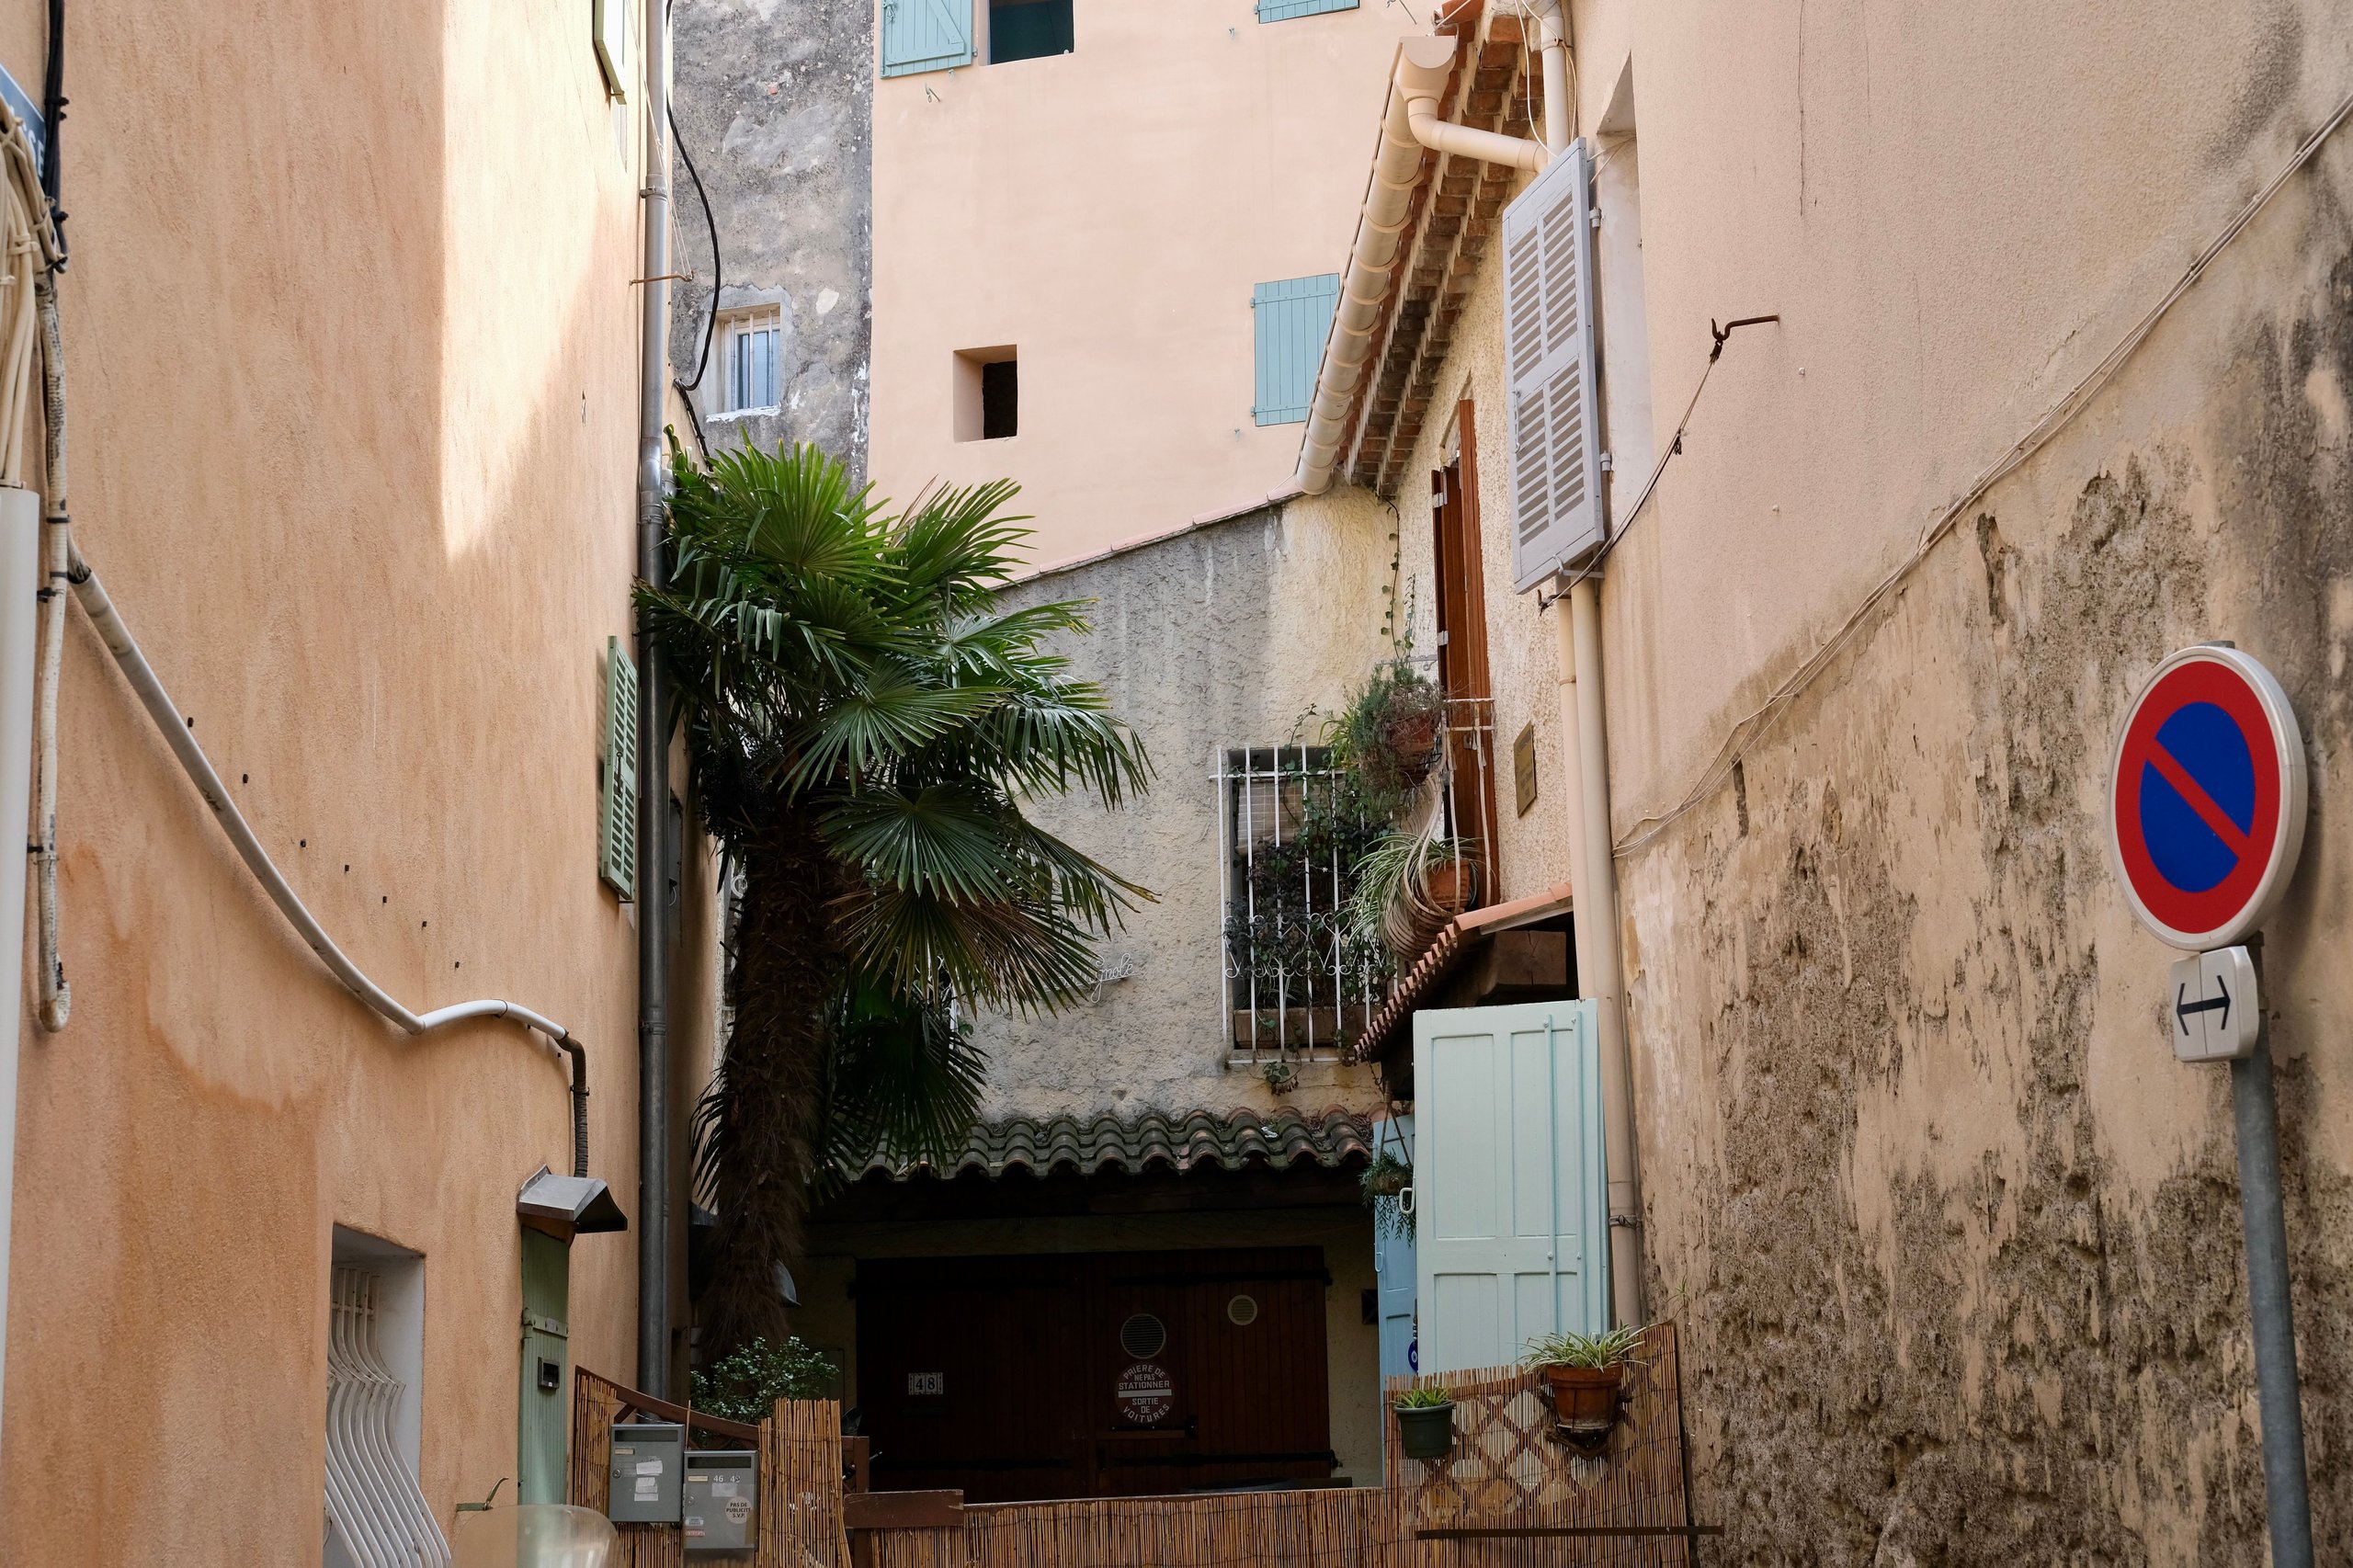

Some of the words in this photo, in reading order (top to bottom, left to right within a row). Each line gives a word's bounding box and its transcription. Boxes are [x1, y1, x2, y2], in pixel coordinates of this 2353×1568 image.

[1123, 1364, 1154, 1380] PRIERE
[1154, 1368, 1165, 1379] DE
[1134, 1373, 1143, 1381] NE
[915, 1377, 935, 1390] 48
[1119, 1380, 1170, 1390] STATIONNER
[1131, 1397, 1159, 1405] SORTIE
[1123, 1403, 1170, 1423] VOITURES
[1141, 1405, 1150, 1414] DE
[713, 1474, 724, 1483] 46
